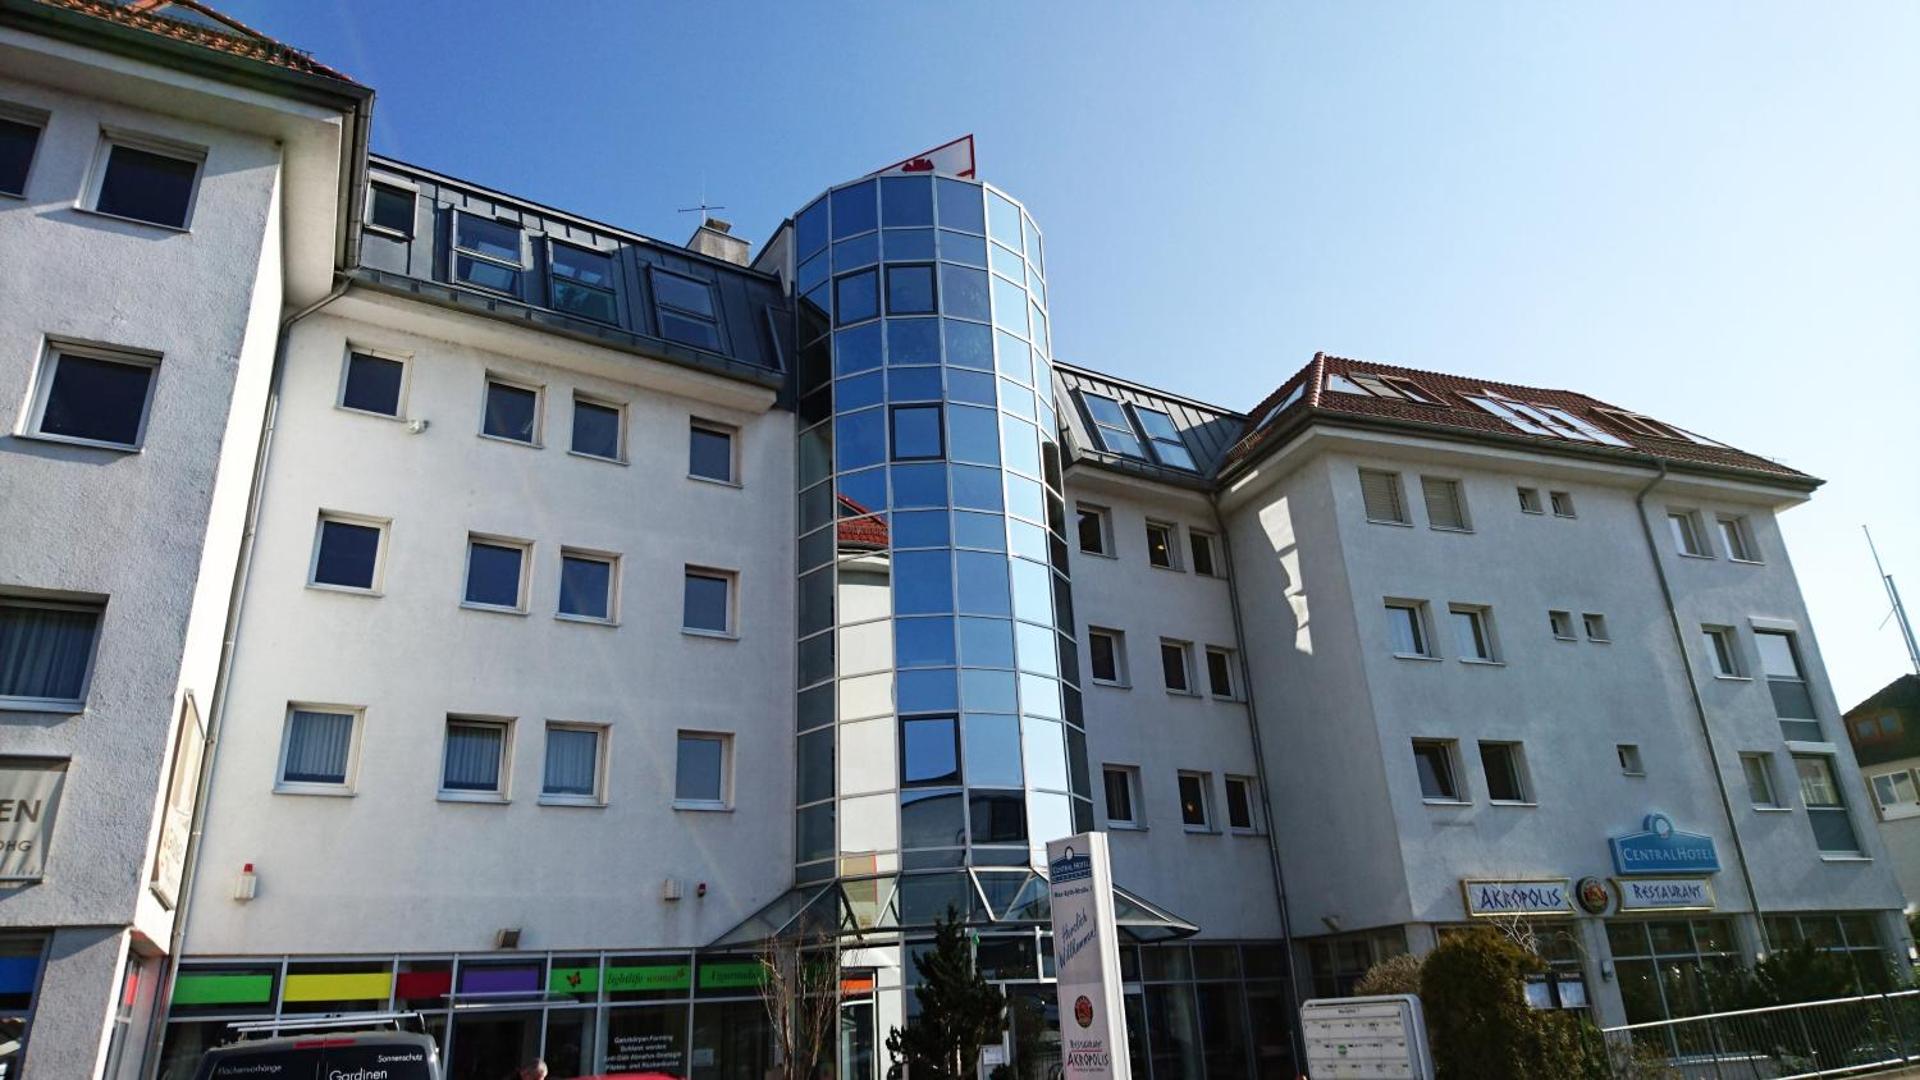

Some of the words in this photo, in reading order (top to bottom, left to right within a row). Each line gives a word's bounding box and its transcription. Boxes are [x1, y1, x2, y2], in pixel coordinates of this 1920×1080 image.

[1481, 887, 1561, 909] AKROPOLIS
[1632, 883, 1700, 901] RESTAURANT
[1067, 1052, 1109, 1067] AKROPOLIS
[329, 1067, 388, 1080] Gardinen
